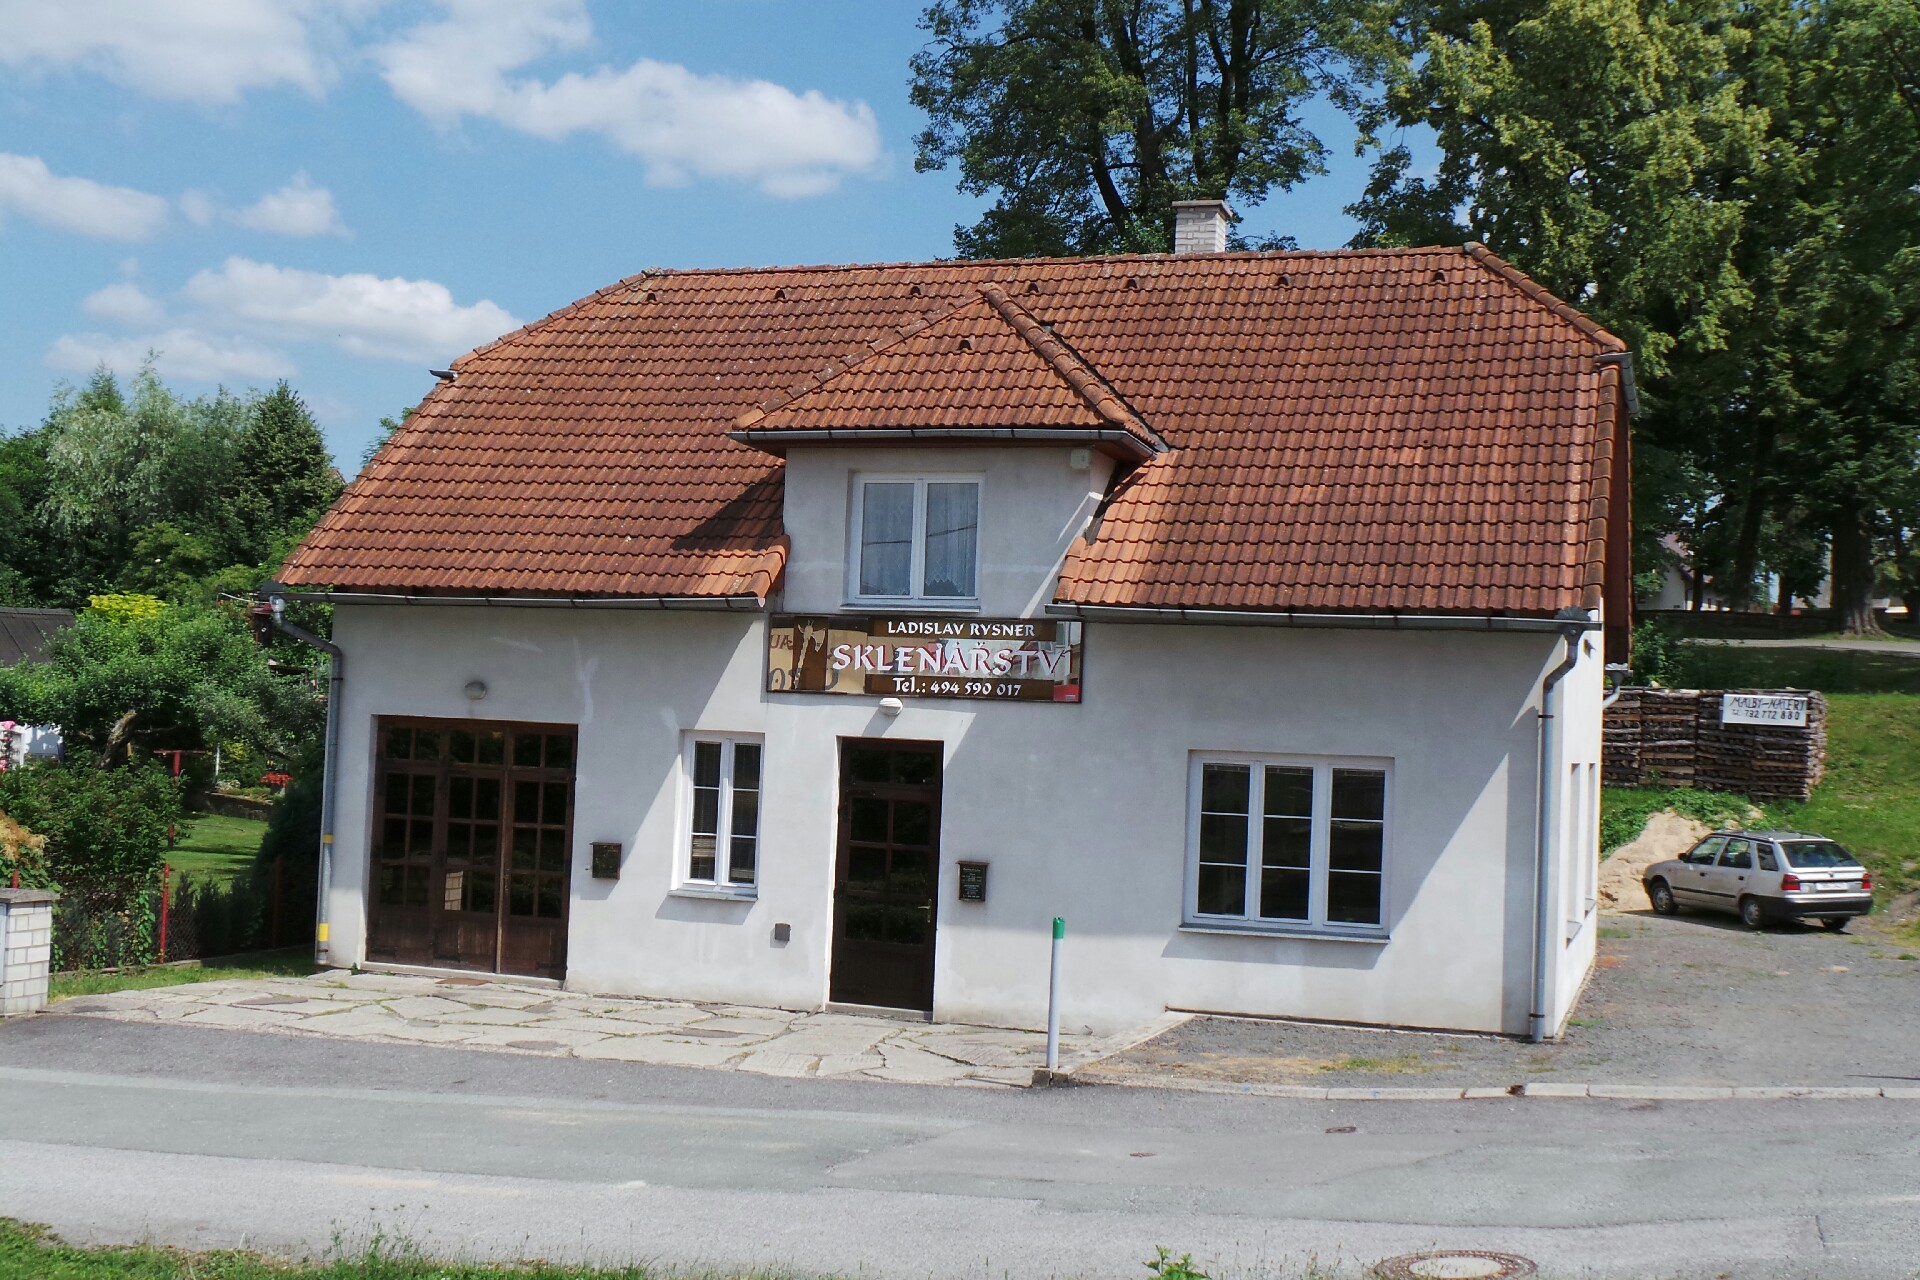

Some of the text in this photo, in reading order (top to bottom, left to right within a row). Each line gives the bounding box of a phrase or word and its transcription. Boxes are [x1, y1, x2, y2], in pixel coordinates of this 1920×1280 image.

[887, 620, 1035, 637] LADISLAV RYSNER
[892, 676, 1022, 696] Tel.: 494 590 017
[1762, 710, 1777, 719] 772
